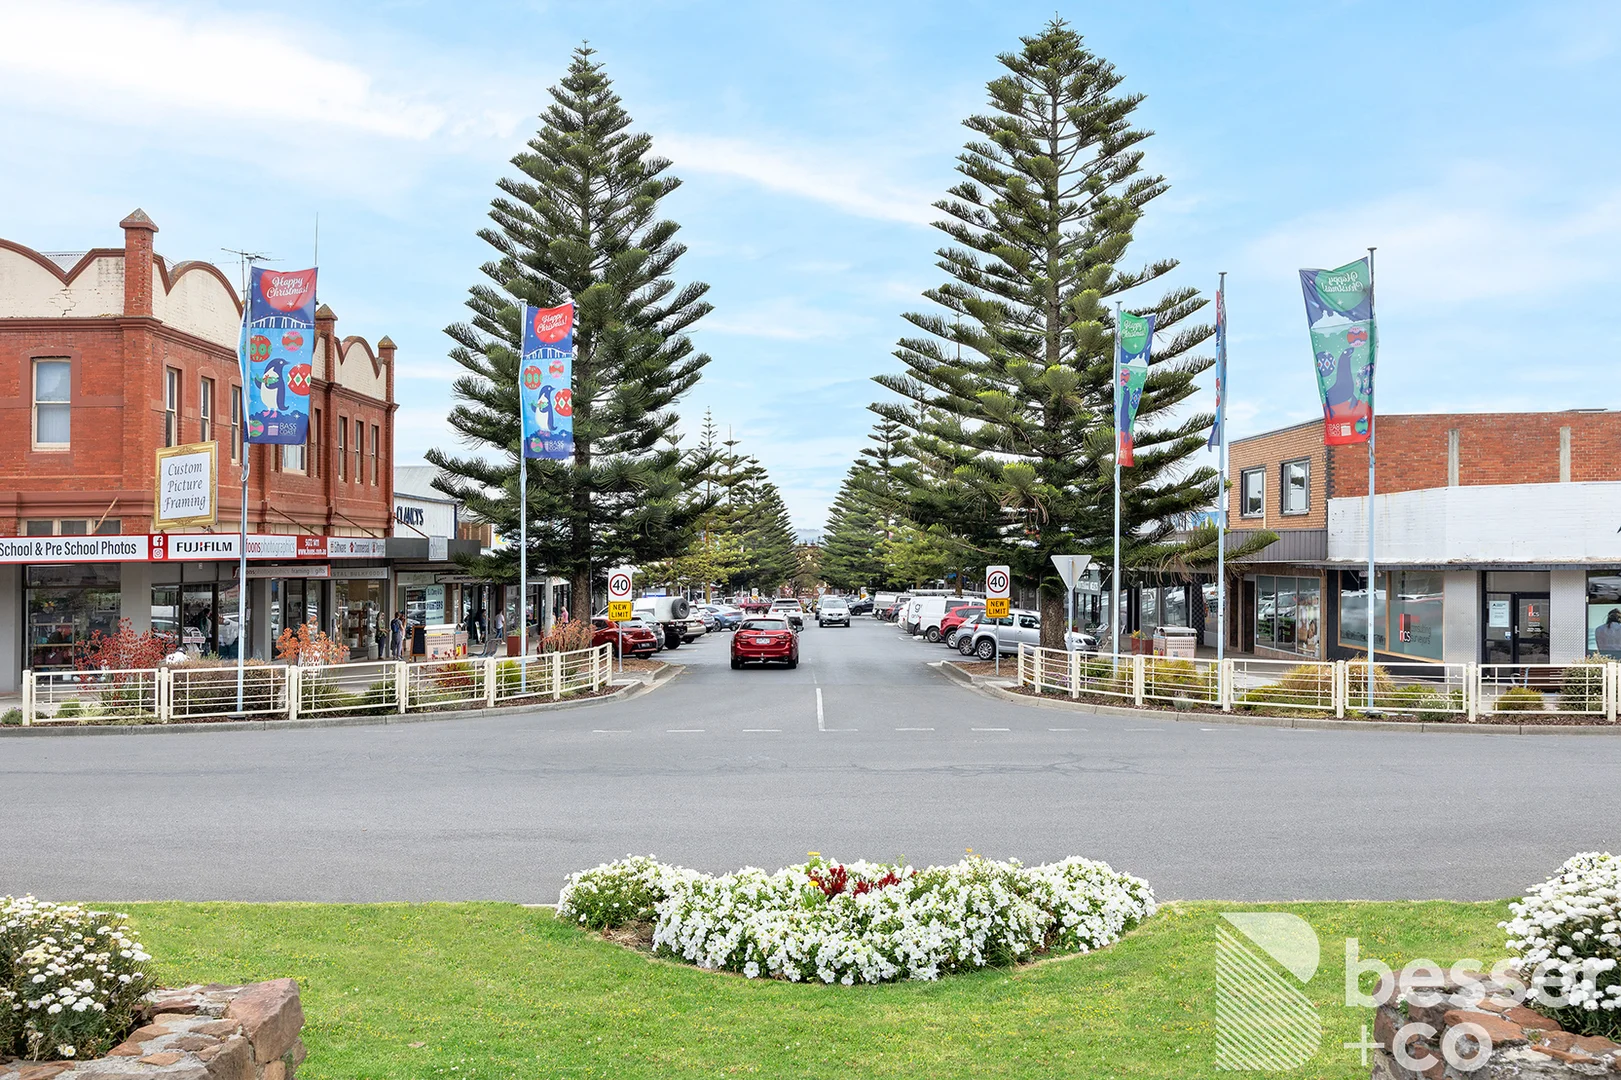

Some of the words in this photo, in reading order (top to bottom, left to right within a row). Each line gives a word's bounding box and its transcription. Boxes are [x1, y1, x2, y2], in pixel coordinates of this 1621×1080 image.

[272, 276, 304, 288] Happy
[266, 282, 309, 299] Christmas!
[167, 463, 203, 477] Custom
[167, 480, 203, 493] Picture
[163, 495, 206, 513] Framing
[0, 542, 32, 556] School
[35, 543, 43, 556] &
[45, 542, 62, 556] Pre
[64, 541, 99, 555] School
[101, 541, 137, 555] Photos
[176, 541, 232, 553] FUJIFILM
[612, 579, 628, 591] 40
[990, 576, 1006, 587] 40
